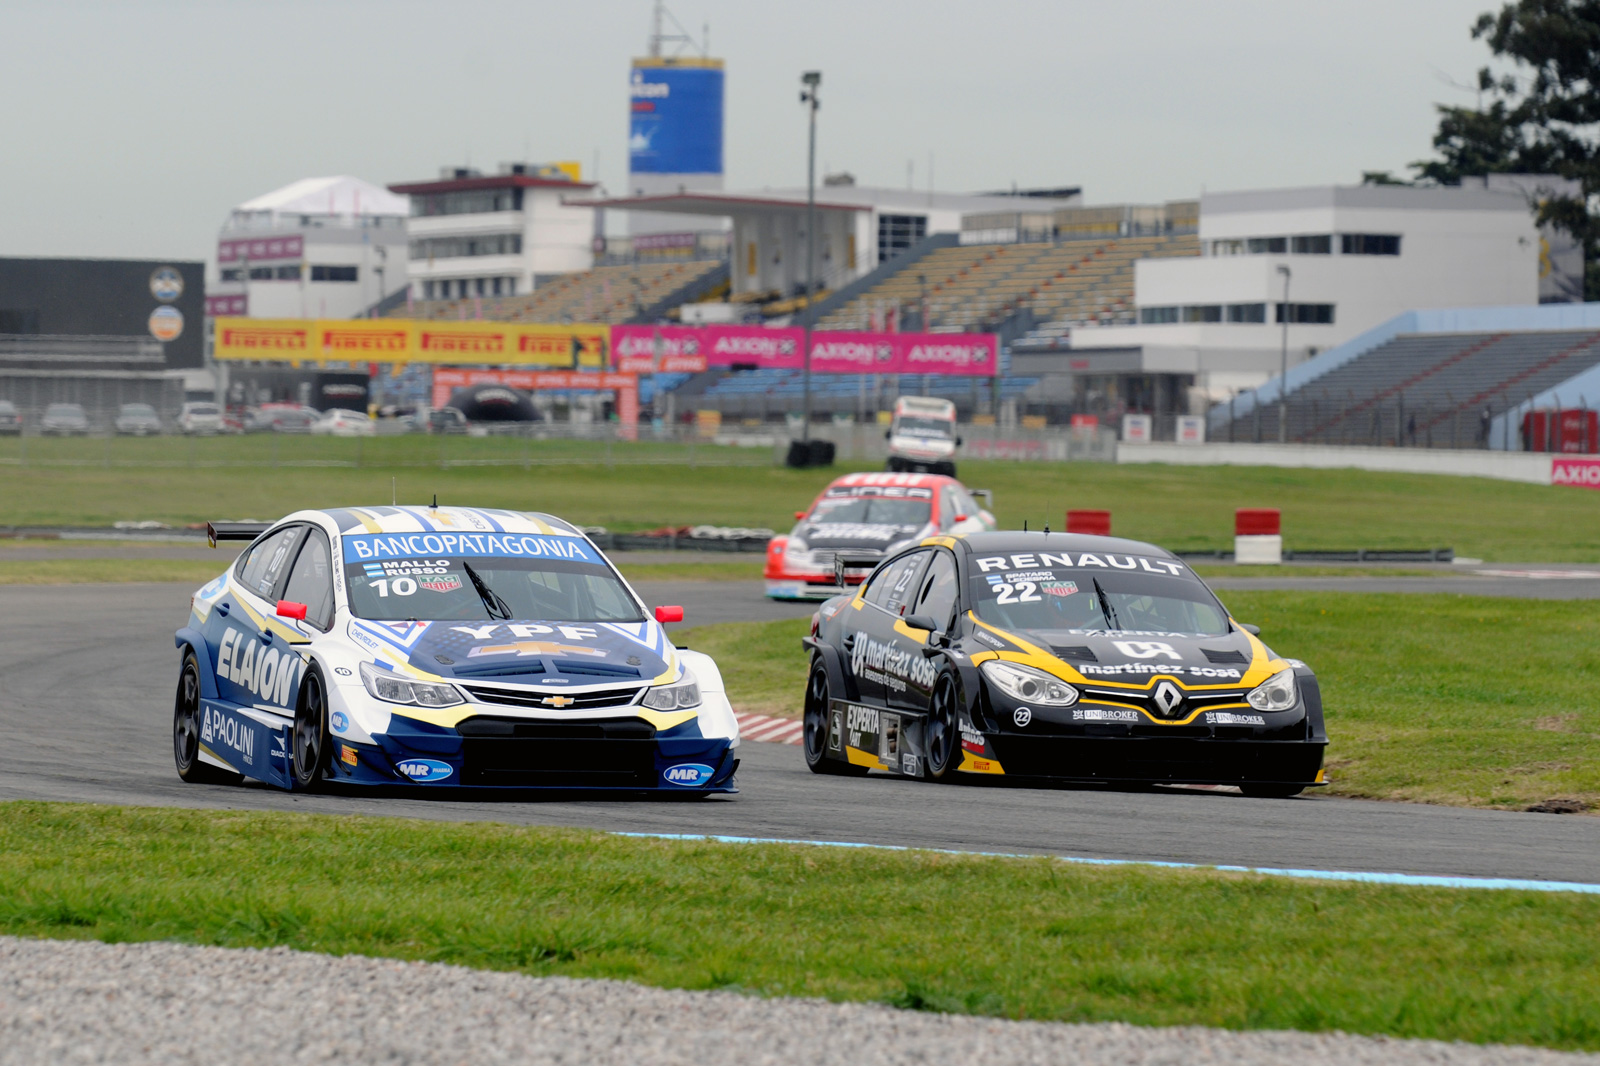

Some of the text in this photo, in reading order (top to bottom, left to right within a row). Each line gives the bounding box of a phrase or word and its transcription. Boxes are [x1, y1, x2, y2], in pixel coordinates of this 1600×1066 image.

[222, 329, 307, 349] PIRELLI
[322, 331, 407, 350] PIRELLI
[421, 333, 505, 352] PIRELLI
[518, 335, 604, 354] PIRELI
[714, 336, 777, 355] AXION
[811, 342, 874, 361] AXION
[908, 344, 971, 363] AXION
[825, 486, 933, 499] LINEA
[352, 534, 589, 560] BANCOPATAGONIA
[382, 559, 450, 569] MALLO
[385, 567, 448, 577] RUSSO
[975, 552, 1184, 576] RENAULT
[1005, 571, 1053, 579] SPATARO
[368, 577, 418, 598] 10
[992, 581, 1043, 605] 22
[450, 624, 598, 640] YPF
[217, 626, 299, 707] ELAION
[910, 655, 937, 688] sosa
[1079, 662, 1241, 678] martínez sosa
[846, 704, 880, 735] EXPERTA
[1016, 711, 1029, 722] 22
[1084, 709, 1139, 721] UNIBROKER
[1216, 712, 1265, 725] UNIBROKER
[213, 709, 254, 757] PAOLINI
[400, 763, 430, 776] MR
[668, 769, 699, 780] MR
